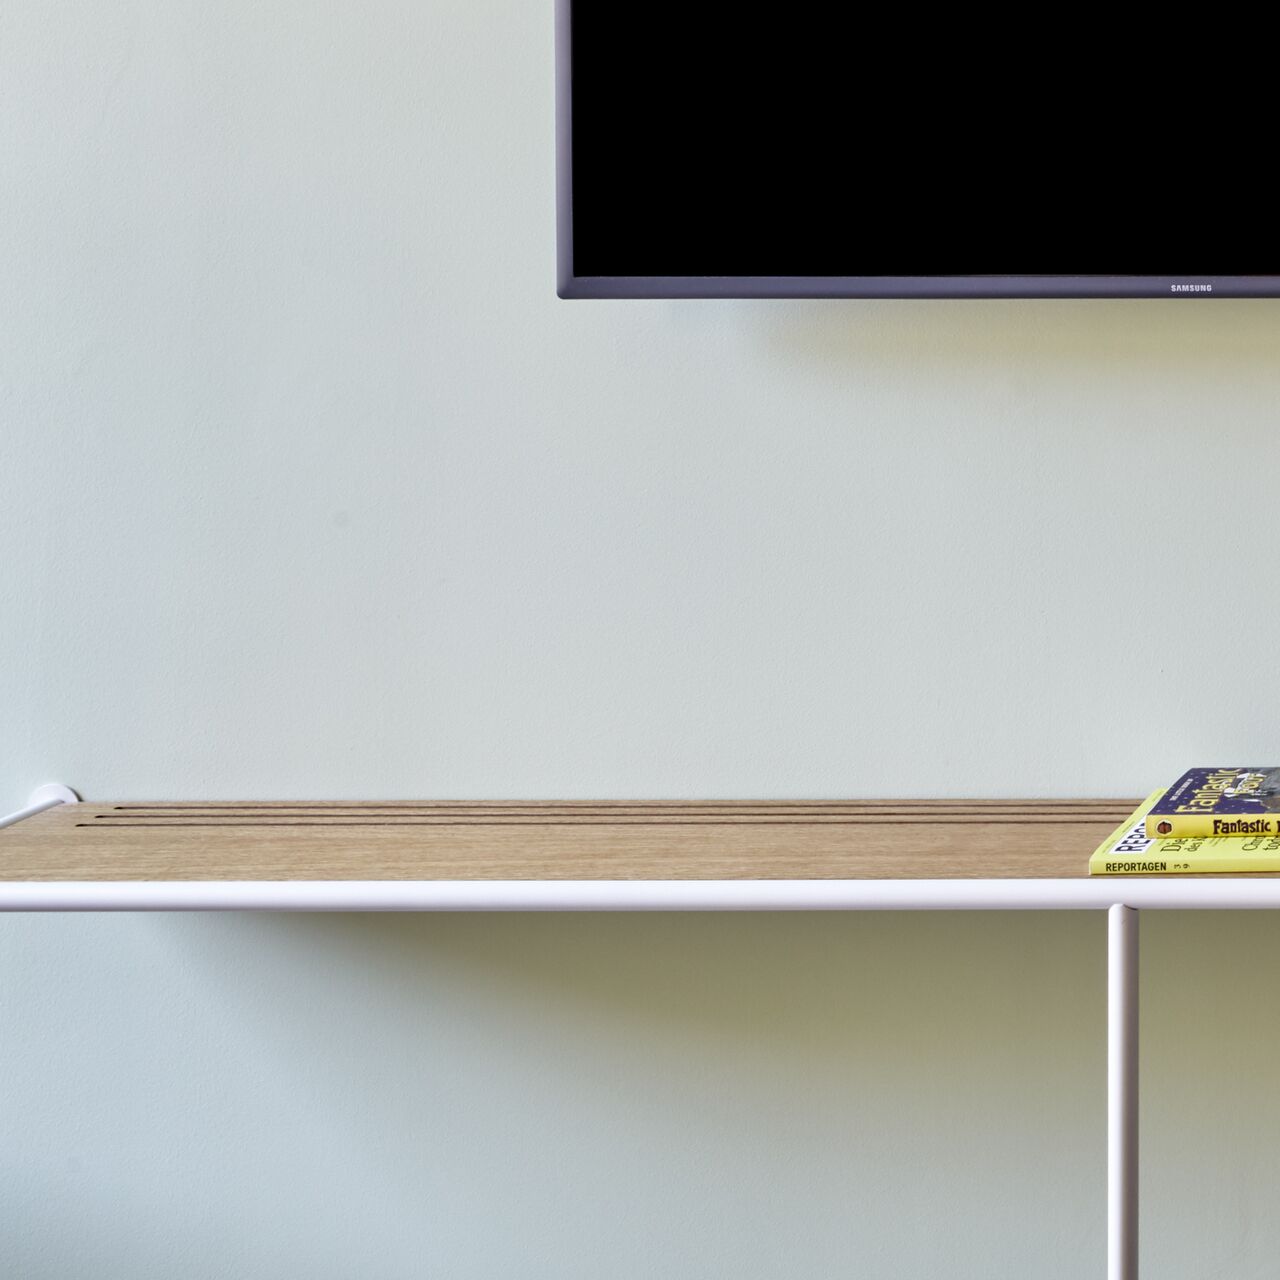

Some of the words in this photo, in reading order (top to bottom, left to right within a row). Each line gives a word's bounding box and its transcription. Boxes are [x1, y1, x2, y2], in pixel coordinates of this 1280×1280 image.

[1170, 284, 1212, 292] SAMSUNG
[1175, 768, 1243, 813] Fantastic
[1213, 818, 1271, 835] Fantastic
[1105, 862, 1168, 872] REPORTAGEN
